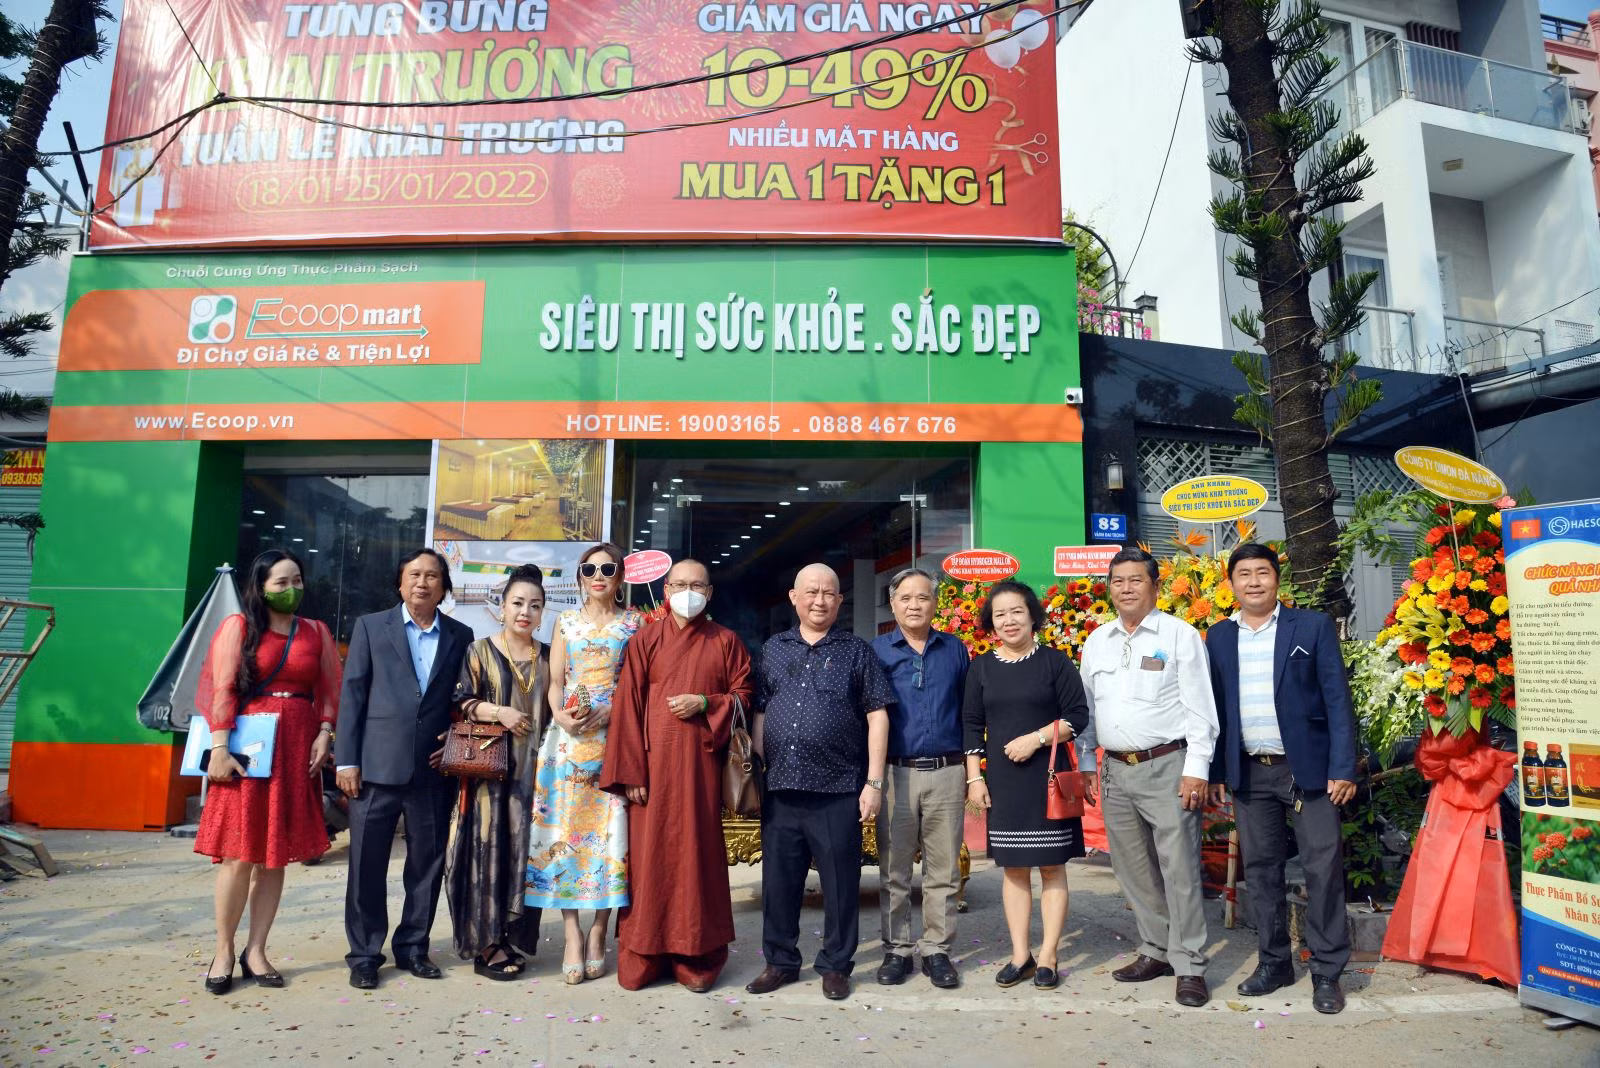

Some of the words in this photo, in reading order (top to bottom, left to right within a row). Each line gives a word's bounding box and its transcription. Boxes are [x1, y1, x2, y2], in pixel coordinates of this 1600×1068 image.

[879, 2, 991, 34] NGAY
[352, 39, 634, 103] TRƯƠNG
[701, 44, 988, 120] 10-49%
[347, 121, 444, 159] KHAI
[457, 118, 626, 155] TRƯƠNG
[728, 119, 808, 147] NHIỀU
[815, 124, 877, 152] MẶT
[882, 125, 959, 152] HÀNG
[248, 169, 538, 207] 18/01-25/01/2022
[680, 163, 800, 201] MUA
[806, 159, 826, 201] 1
[832, 156, 980, 209] TẶNG
[986, 165, 1007, 207] 1
[166, 267, 209, 278] Chuỗi
[213, 267, 252, 278] Cung
[292, 264, 330, 275] Thực
[381, 262, 418, 274] Sạch
[245, 298, 359, 339] Ecoop
[363, 304, 422, 325] mart
[538, 294, 620, 351] SIÊU
[630, 302, 686, 358] THỊ
[695, 292, 766, 352] SỨC
[773, 286, 866, 352] KHỎE
[971, 304, 1041, 360] ĐẸP
[177, 348, 201, 363] Đi
[204, 347, 250, 367] Chợ
[253, 343, 288, 362] Giá
[292, 343, 320, 361] Rẻ
[325, 345, 341, 360] &
[347, 343, 392, 363] Tiện
[396, 344, 430, 362] Lợi
[134, 412, 295, 432] www.Ecoop.vn
[566, 414, 671, 432] HOTLINE:
[677, 414, 781, 432] 19003165
[808, 415, 863, 433] 0888
[868, 415, 910, 434] 467
[916, 416, 957, 434] 676
[1098, 517, 1120, 531] 85
[1525, 881, 1545, 897] Thực
